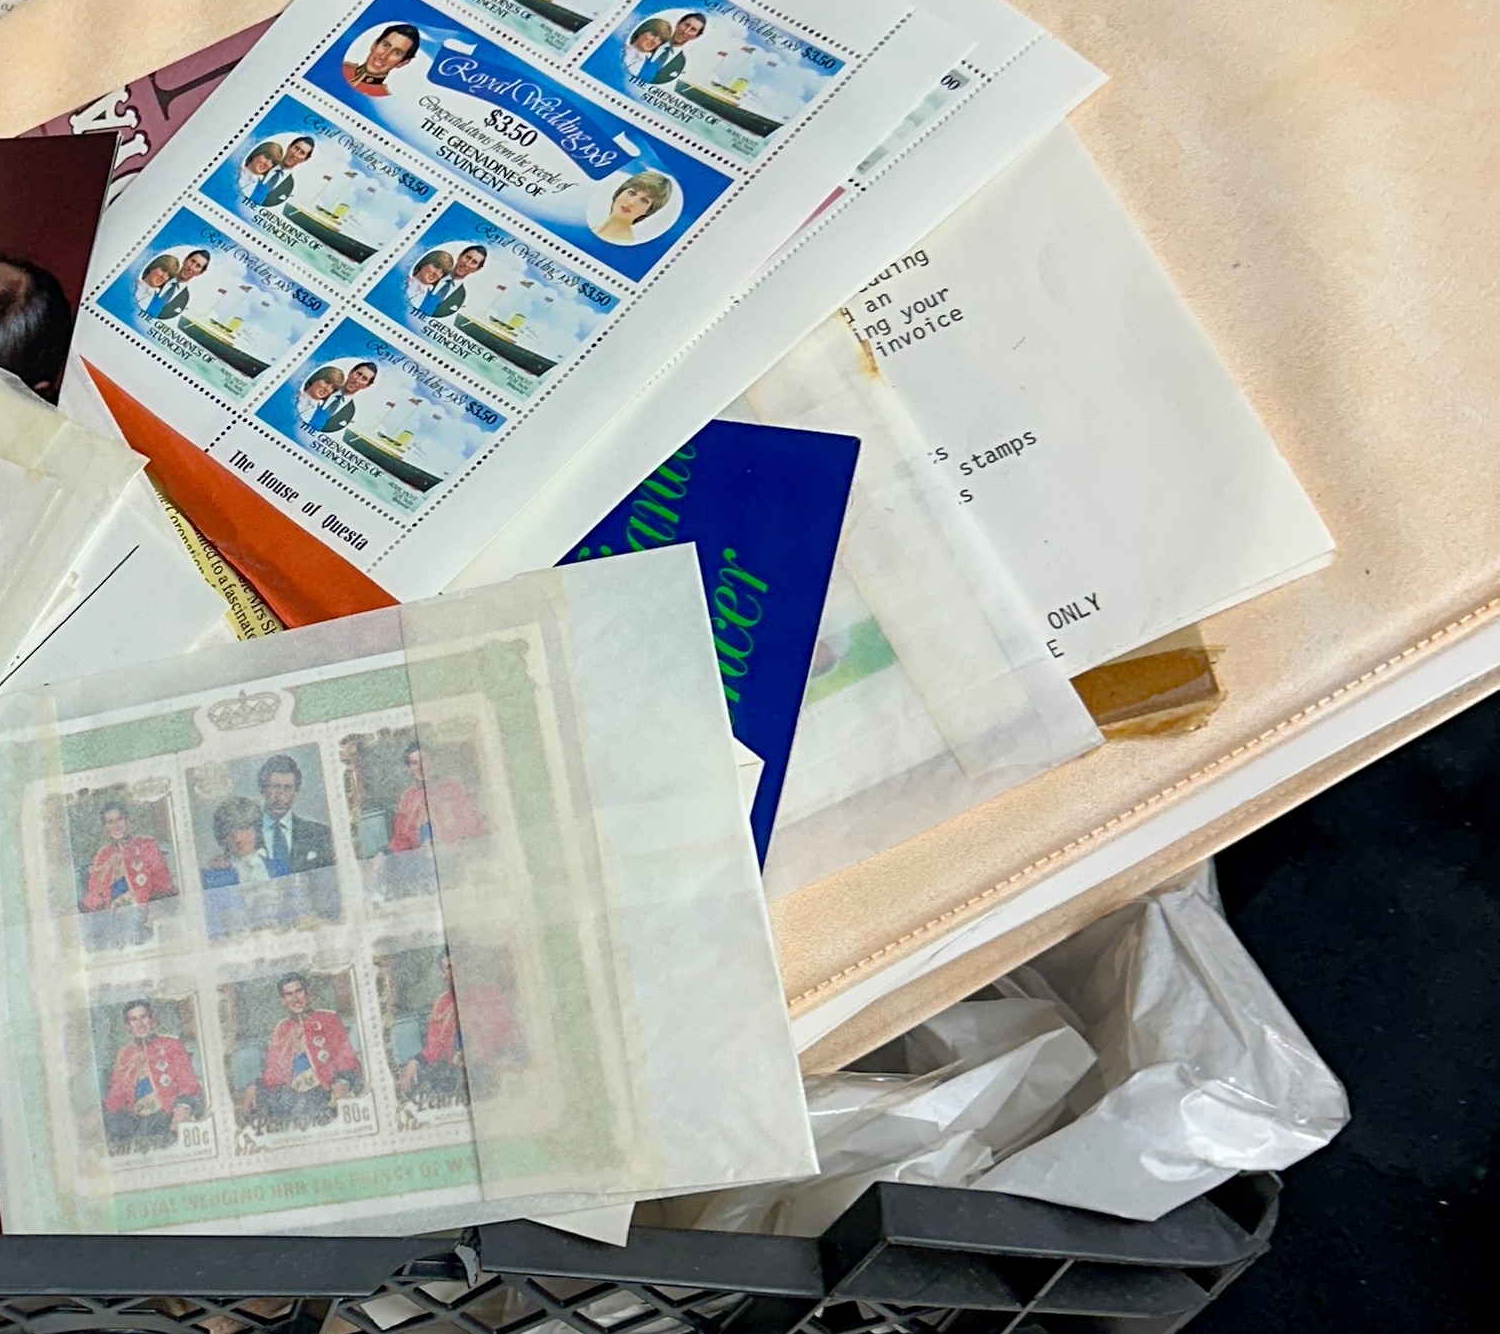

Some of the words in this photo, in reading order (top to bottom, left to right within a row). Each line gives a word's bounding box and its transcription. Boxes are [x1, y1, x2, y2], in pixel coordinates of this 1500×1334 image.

[518, 6, 536, 21] OF
[437, 54, 515, 102] Royal
[512, 82, 592, 153] Wedding
[418, 95, 495, 147] Congratulations
[487, 139, 516, 160] from
[512, 153, 532, 168] the
[522, 164, 562, 186] people
[551, 182, 580, 194] of
[484, 108, 538, 148] $3.50
[420, 117, 449, 141] THE
[443, 133, 526, 189] GRENADINES
[524, 182, 547, 197] OF
[435, 145, 510, 194] ST.VINCENT
[241, 196, 258, 211] THE
[258, 207, 310, 243] GRENADINES
[308, 237, 323, 252] OF
[865, 292, 892, 314] an
[900, 287, 949, 324] your
[875, 306, 965, 357] invoice
[959, 431, 1037, 476] stamps
[229, 449, 255, 475] The
[257, 470, 300, 504] House
[301, 501, 320, 518] of
[318, 513, 370, 552] Questa
[211, 559, 224, 575] to
[218, 576, 228, 585] a
[1046, 593, 1105, 630] ONLY
[343, 1103, 370, 1124] 80c
[182, 1128, 209, 1148] 80c
